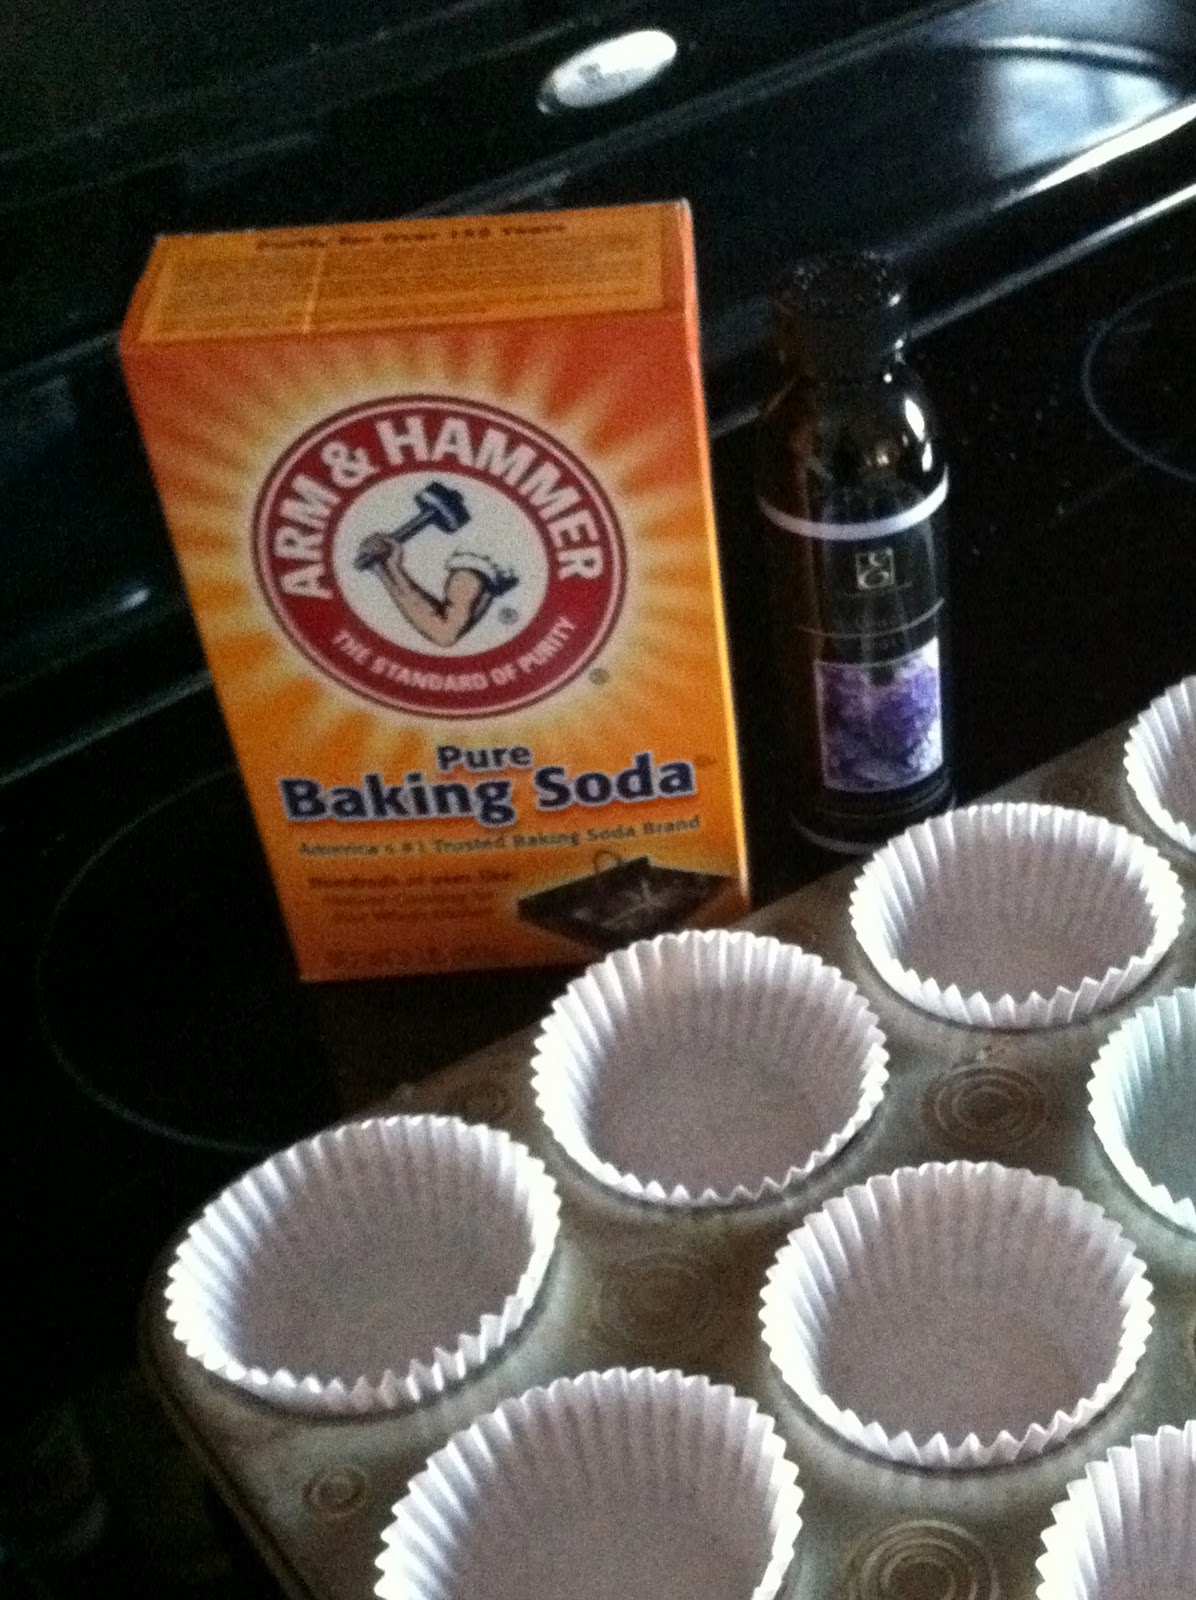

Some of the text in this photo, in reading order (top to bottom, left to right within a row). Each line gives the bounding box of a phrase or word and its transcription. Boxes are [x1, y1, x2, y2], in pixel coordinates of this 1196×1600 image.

[273, 415, 604, 600] ARM & HAMMER
[332, 629, 373, 666] THE
[370, 657, 490, 693] STANDARD
[490, 662, 519, 687] OF
[279, 750, 697, 827] Baking Soda
[437, 744, 532, 772] Pure
[512, 831, 580, 848] Baking
[586, 824, 637, 842] Soda
[643, 814, 701, 835] Brand
